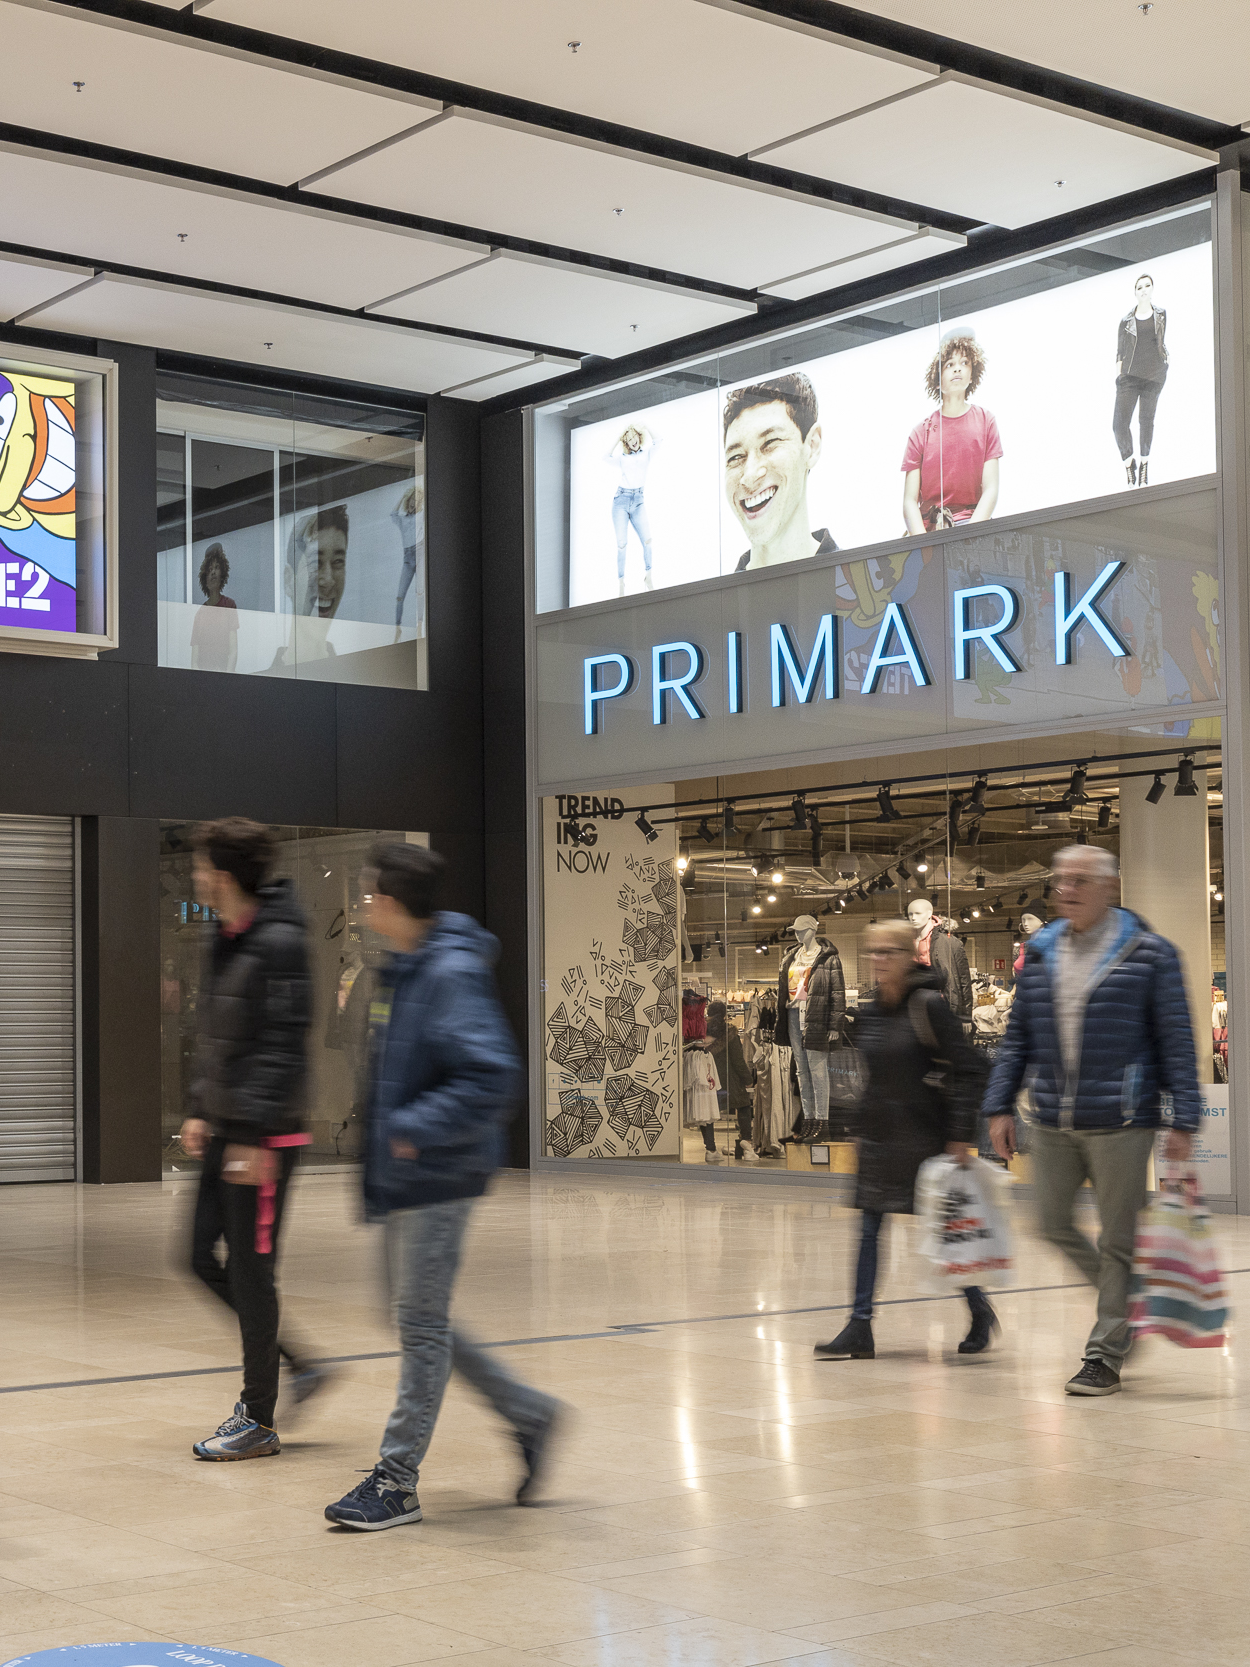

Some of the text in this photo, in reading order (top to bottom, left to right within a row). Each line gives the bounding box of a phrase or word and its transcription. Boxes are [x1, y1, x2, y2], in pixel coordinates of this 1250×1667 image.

[584, 560, 1134, 736] PRIMARK
[555, 795, 625, 821] TREND
[556, 849, 611, 875] NOW
[166, 1650, 214, 1665] LOOP
